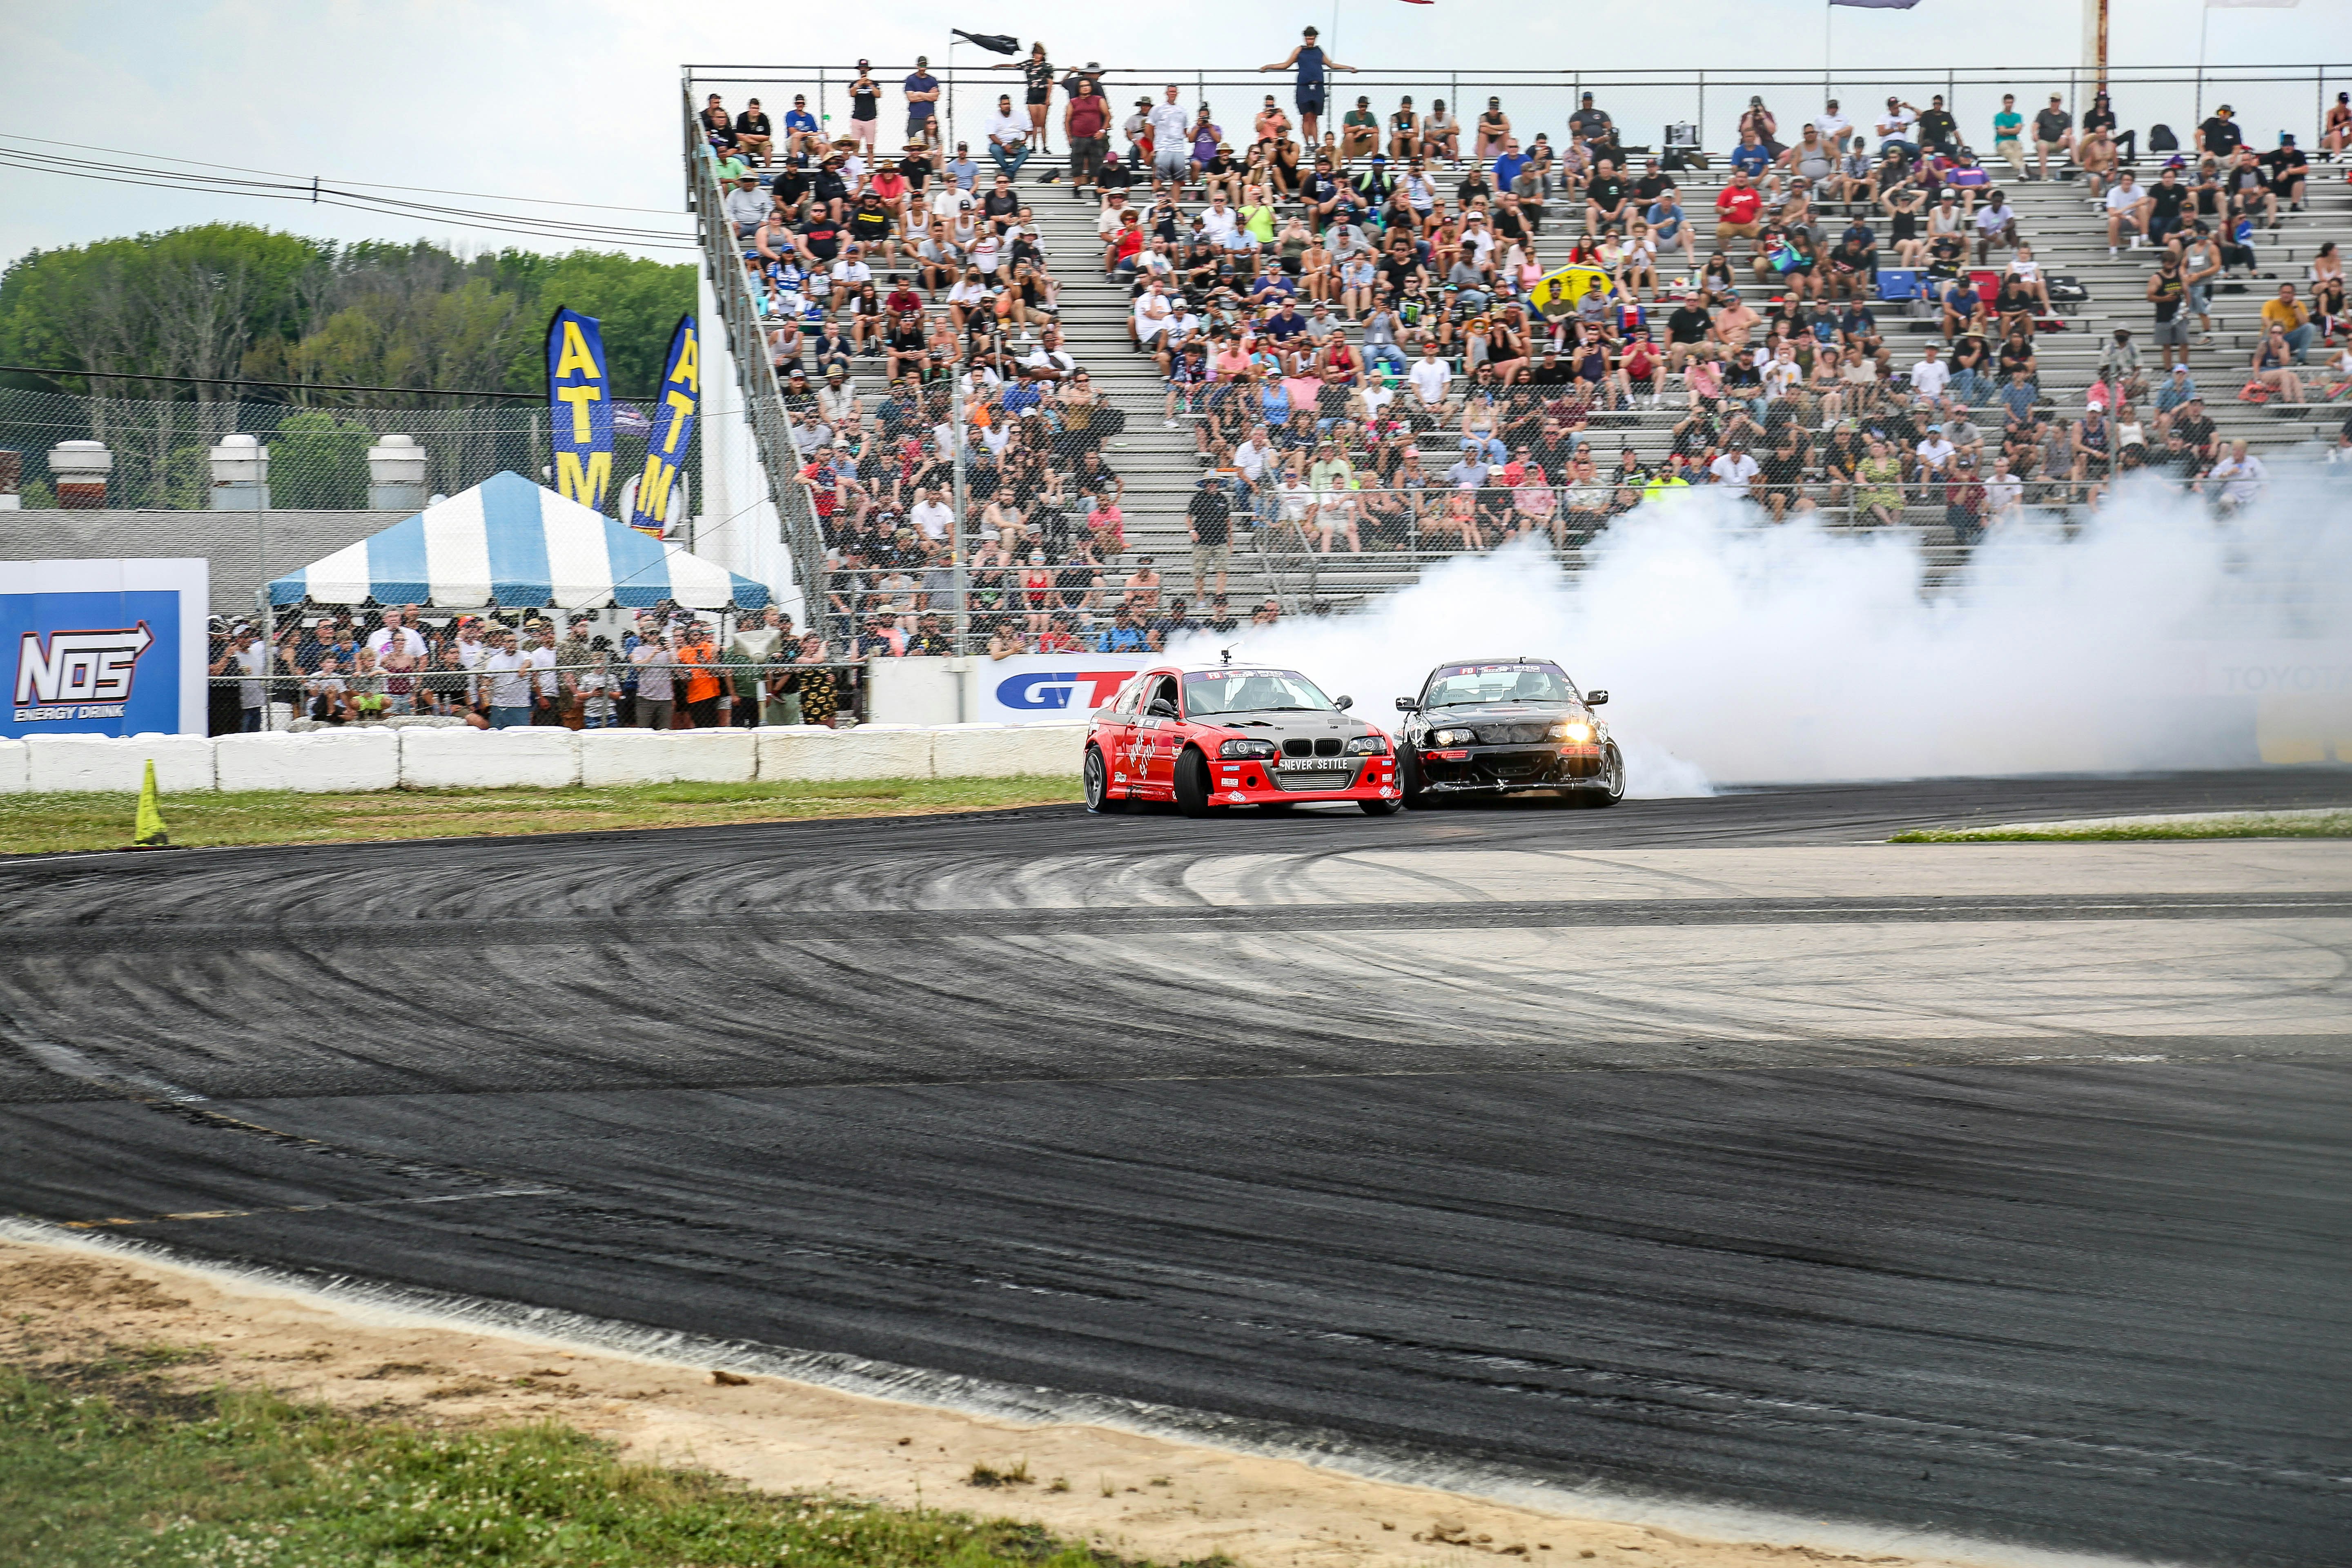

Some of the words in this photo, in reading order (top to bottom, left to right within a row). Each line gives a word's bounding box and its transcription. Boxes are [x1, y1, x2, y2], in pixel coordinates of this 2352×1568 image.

[555, 321, 613, 509] ATM
[637, 328, 698, 521] ATM
[14, 621, 155, 706] NOS
[996, 672, 1138, 709] GT
[13, 707, 77, 722] ENERGY
[78, 705, 126, 719] DRINK
[1129, 729, 1144, 768] NEVER
[1139, 735, 1156, 780] SETTLE
[1284, 760, 1313, 771] NEVER
[1317, 759, 1348, 769] SETTLE
